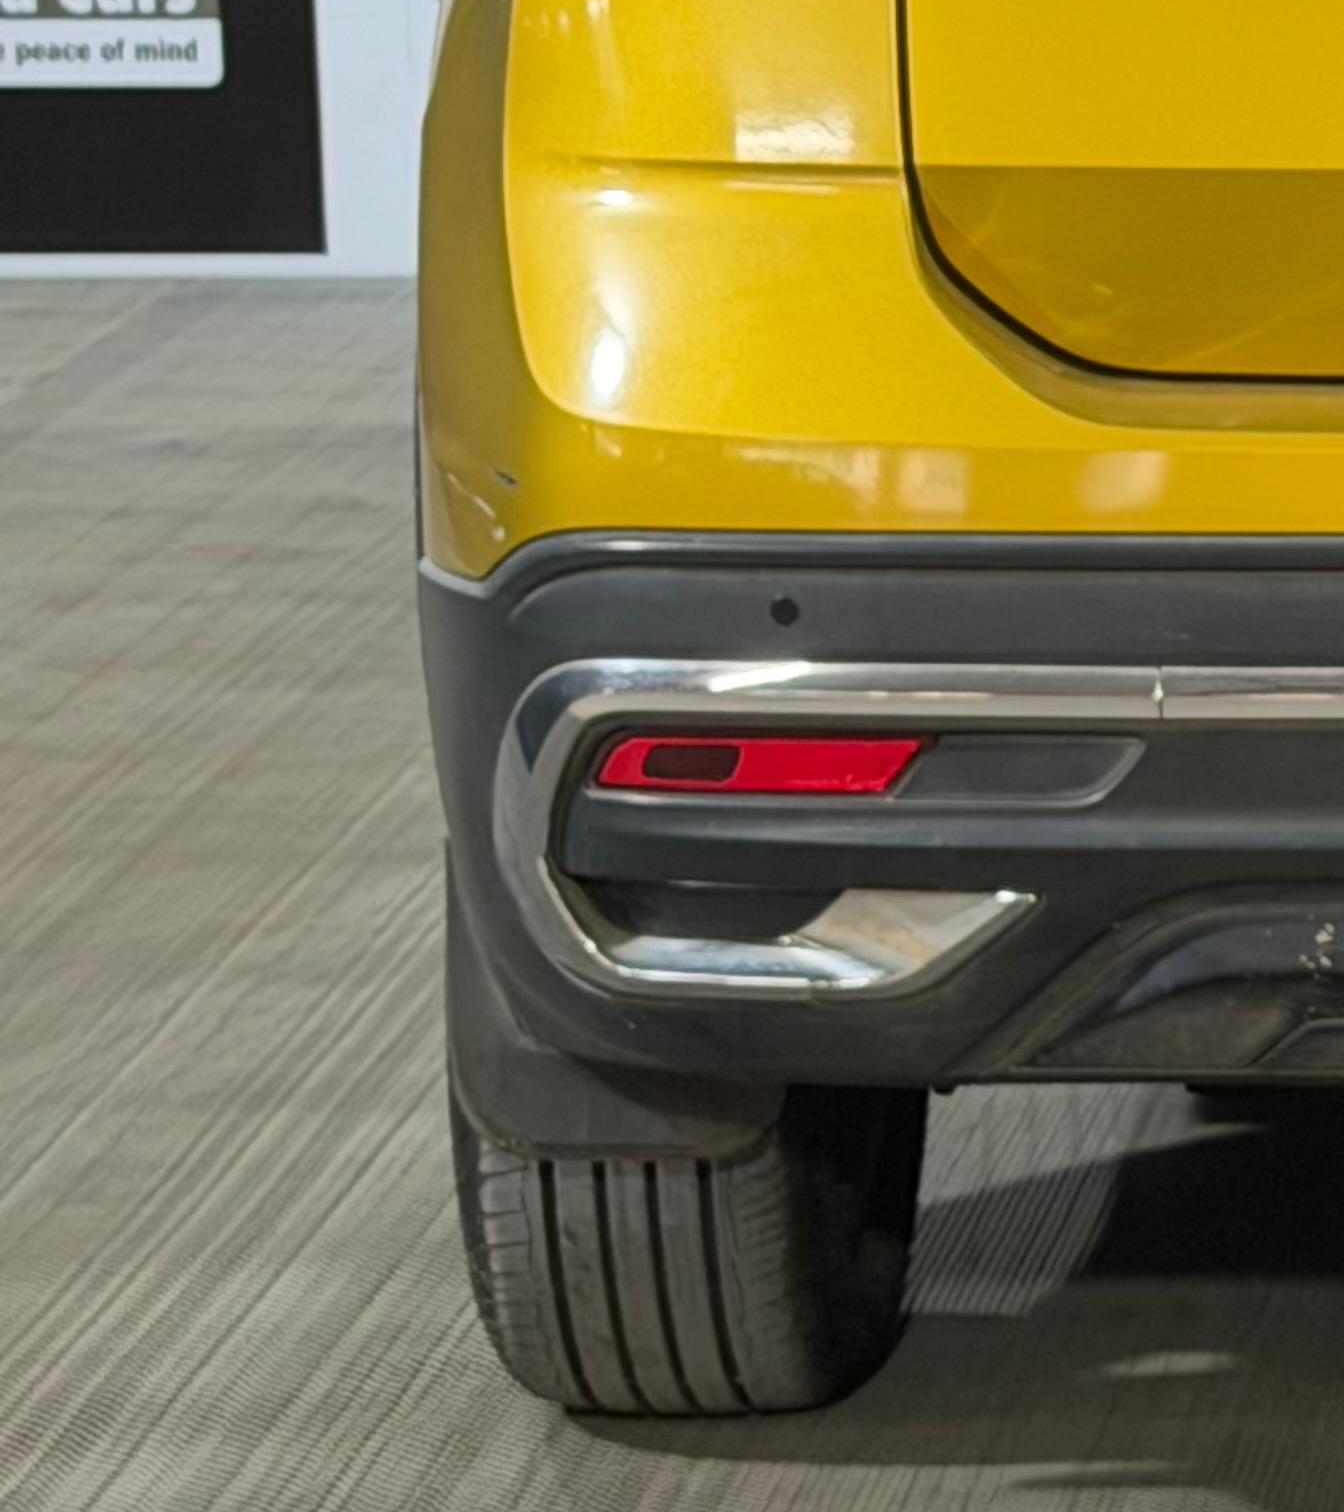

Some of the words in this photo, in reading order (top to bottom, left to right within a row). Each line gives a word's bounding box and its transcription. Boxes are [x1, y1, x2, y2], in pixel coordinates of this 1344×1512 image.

[15, 42, 91, 67] peace
[100, 38, 124, 61] of
[135, 37, 198, 62] mind
